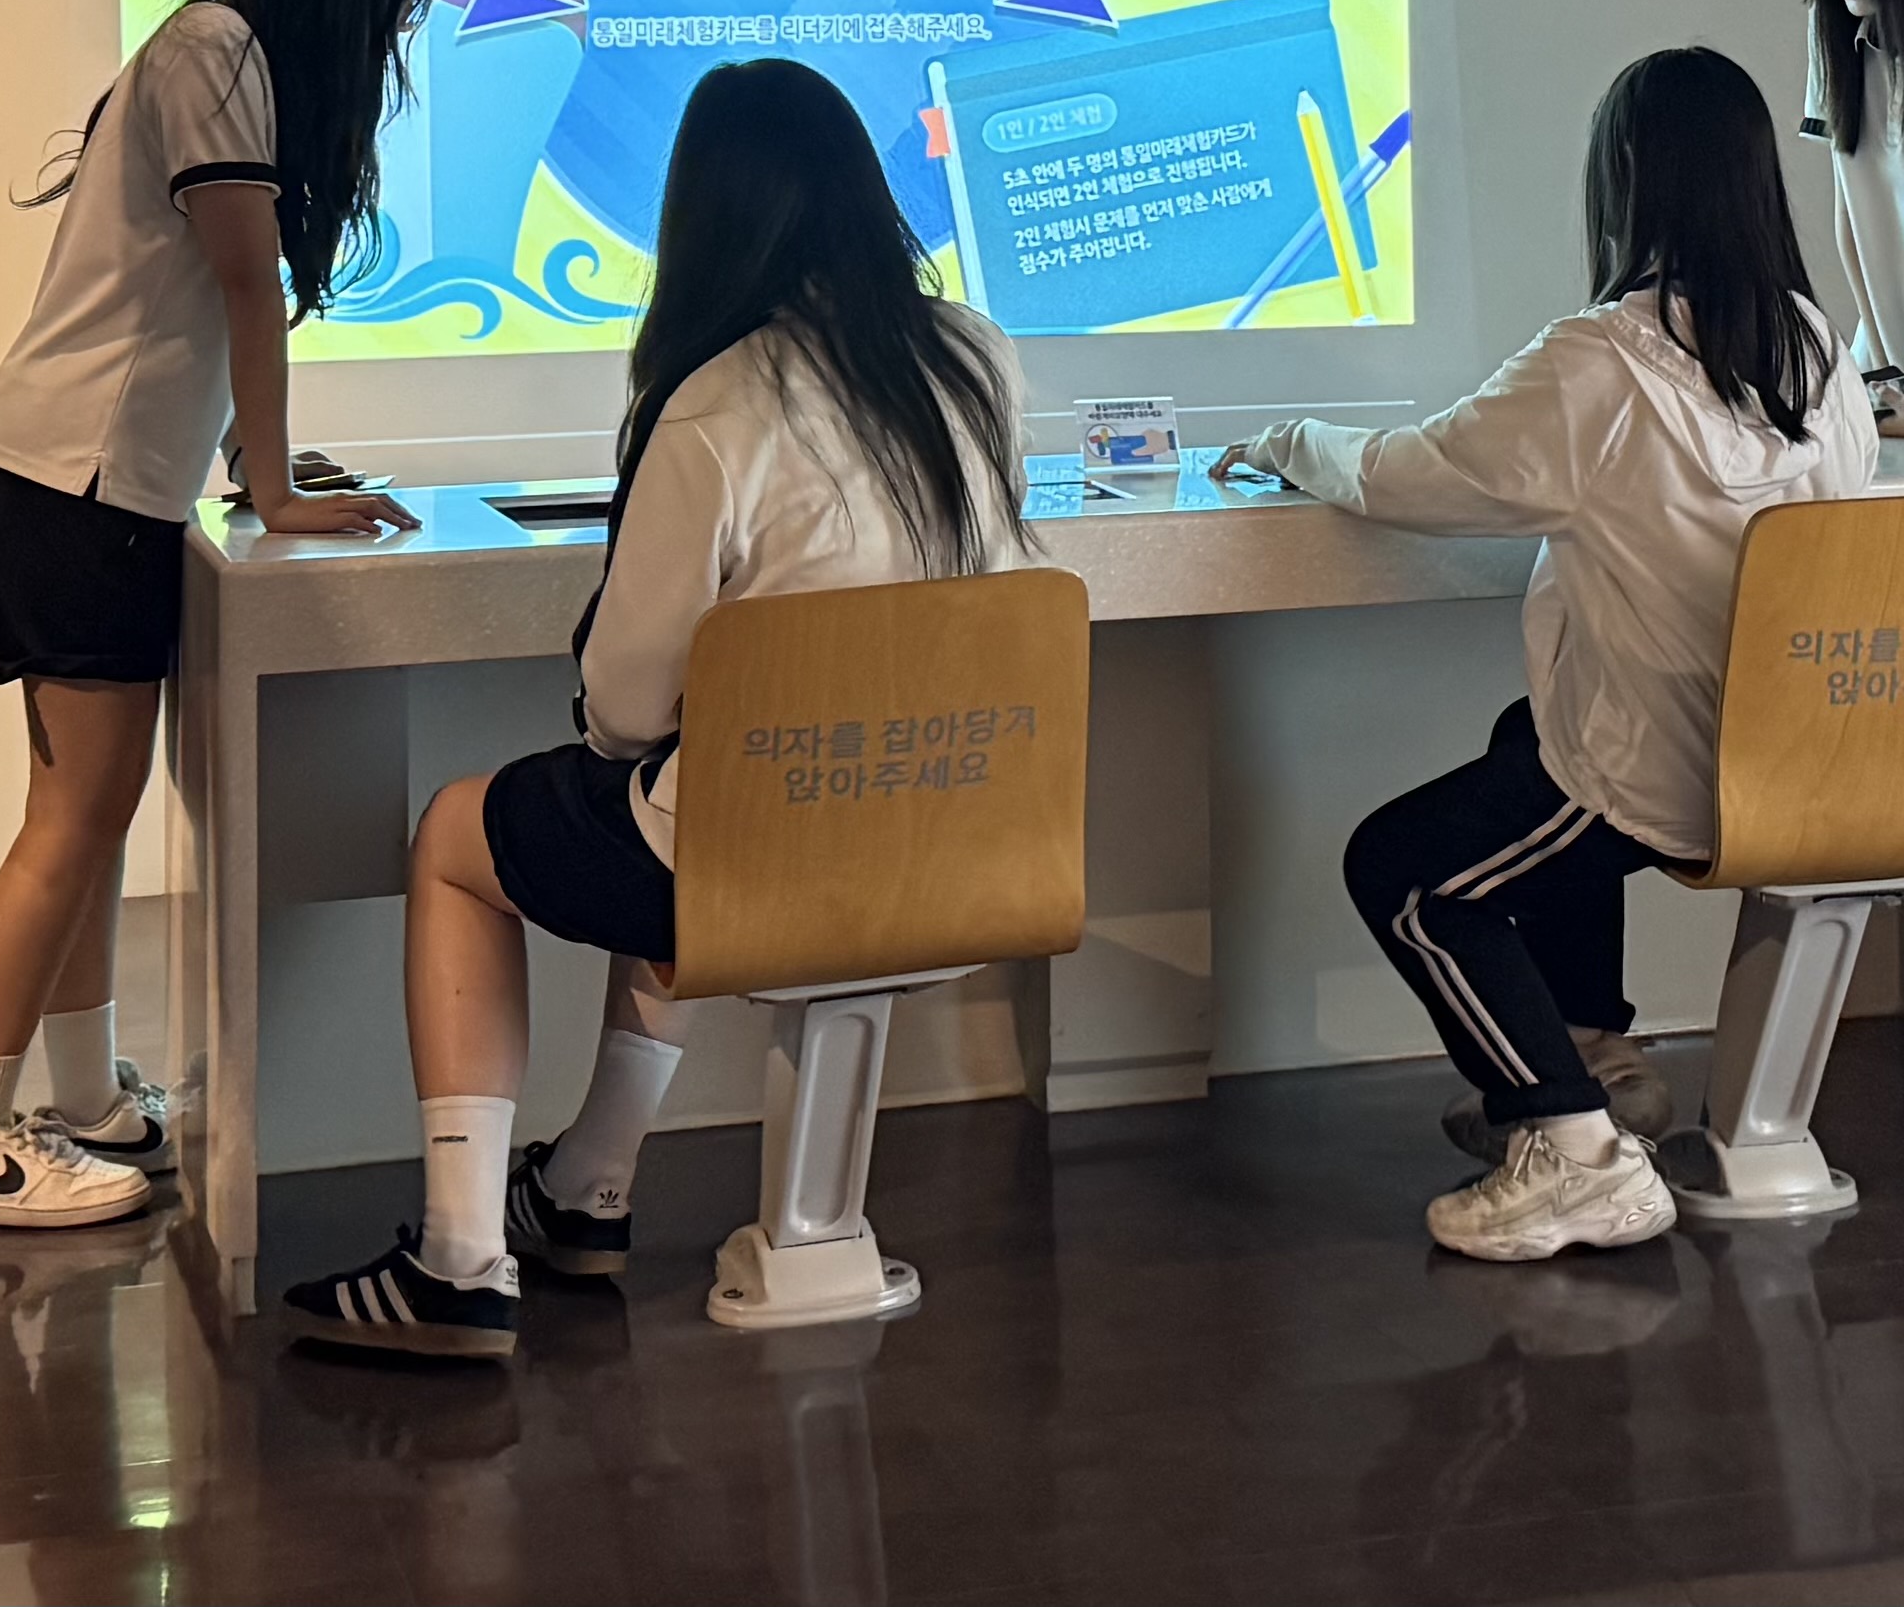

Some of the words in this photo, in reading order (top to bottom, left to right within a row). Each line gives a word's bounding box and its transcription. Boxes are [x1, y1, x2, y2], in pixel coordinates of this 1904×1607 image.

[593, 15, 777, 48] 통일미래체험카드를
[781, 15, 862, 44] 리더기에
[998, 118, 1024, 140] 1인
[1039, 111, 1067, 133] 2인
[1002, 167, 1032, 190] 5초
[1031, 159, 1066, 185] 안에
[1067, 155, 1085, 177] 두
[1085, 149, 1119, 174] 명의
[1007, 185, 1072, 217] 인식되면
[1072, 178, 1101, 202] 2인
[1014, 225, 1042, 249] 2인
[1141, 197, 1175, 223] 먼저
[1786, 625, 1902, 665] 의자를
[742, 721, 866, 761] 의자를
[783, 750, 991, 805] 앉아주세요
